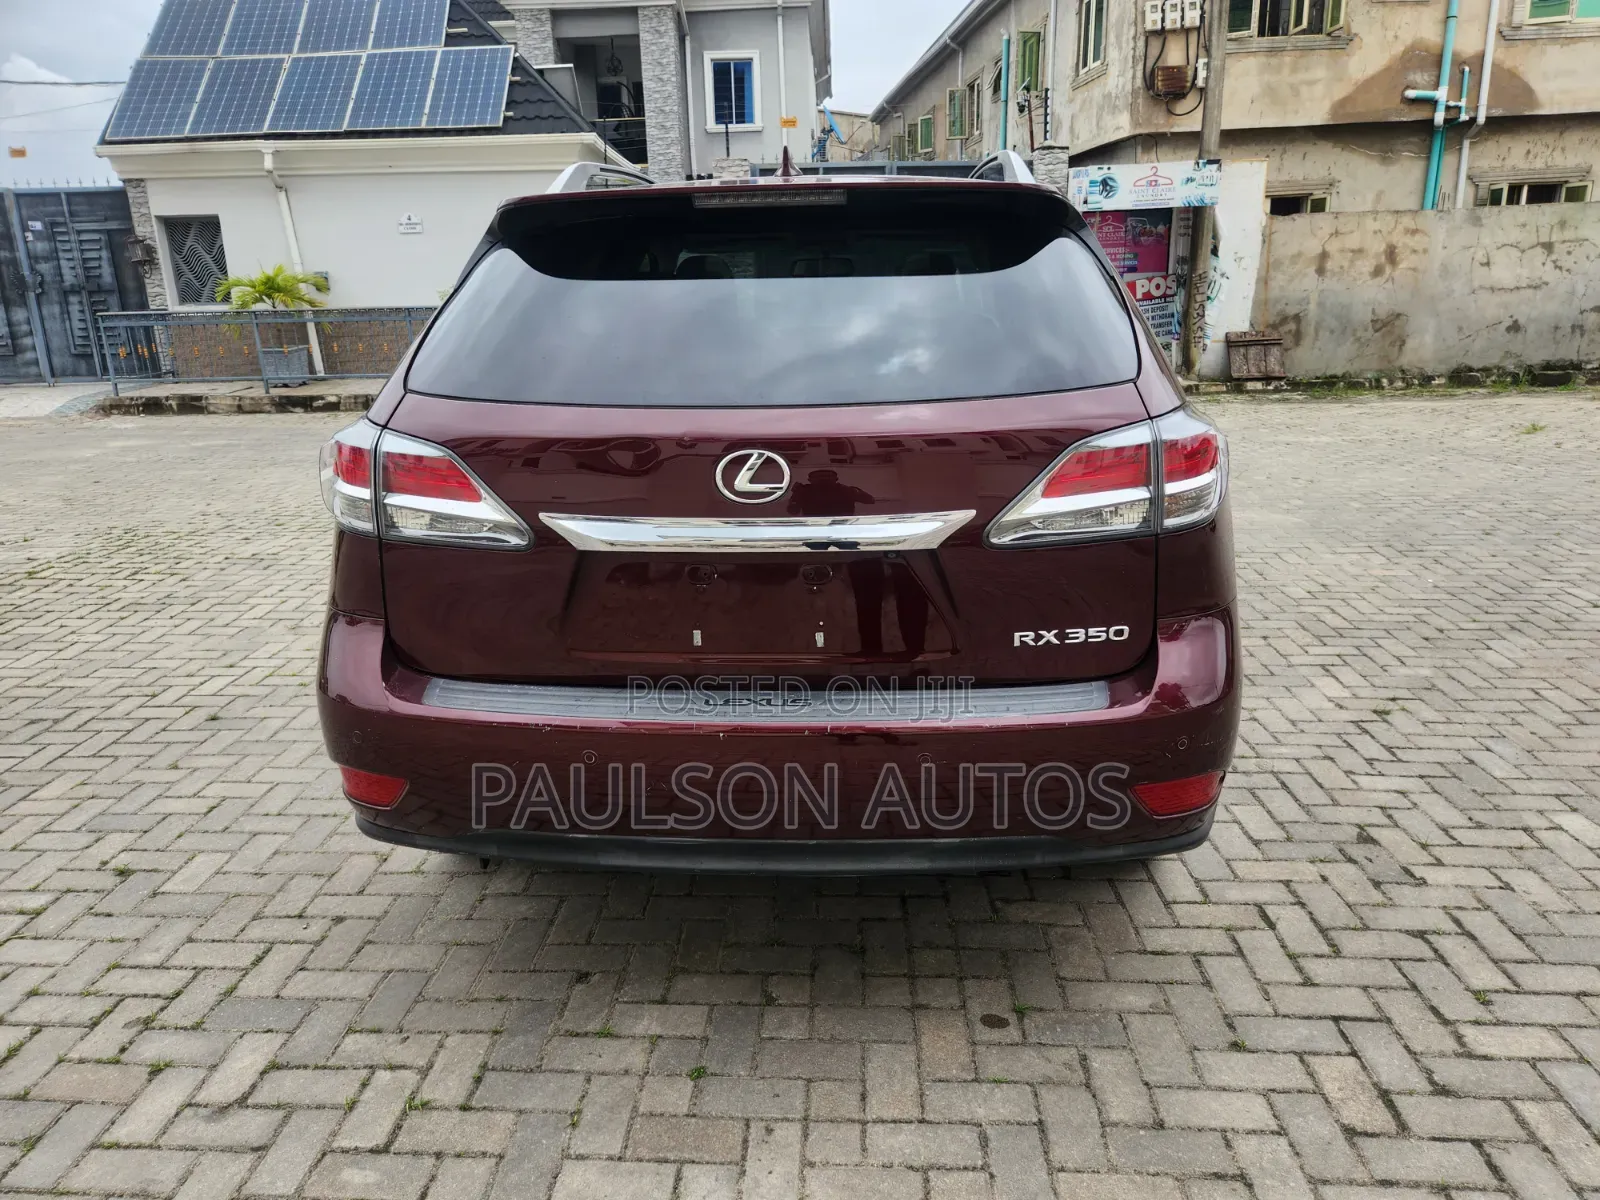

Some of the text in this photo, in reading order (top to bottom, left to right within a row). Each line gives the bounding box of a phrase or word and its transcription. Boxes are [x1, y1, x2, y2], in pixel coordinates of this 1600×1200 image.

[1151, 186, 1176, 194] CLAIRE
[1136, 275, 1176, 299] POS
[1150, 304, 1169, 313] DEPOSIT
[1150, 320, 1173, 329] TRANSFER
[1013, 625, 1130, 647] RX 350
[703, 697, 813, 707] LEXUS
